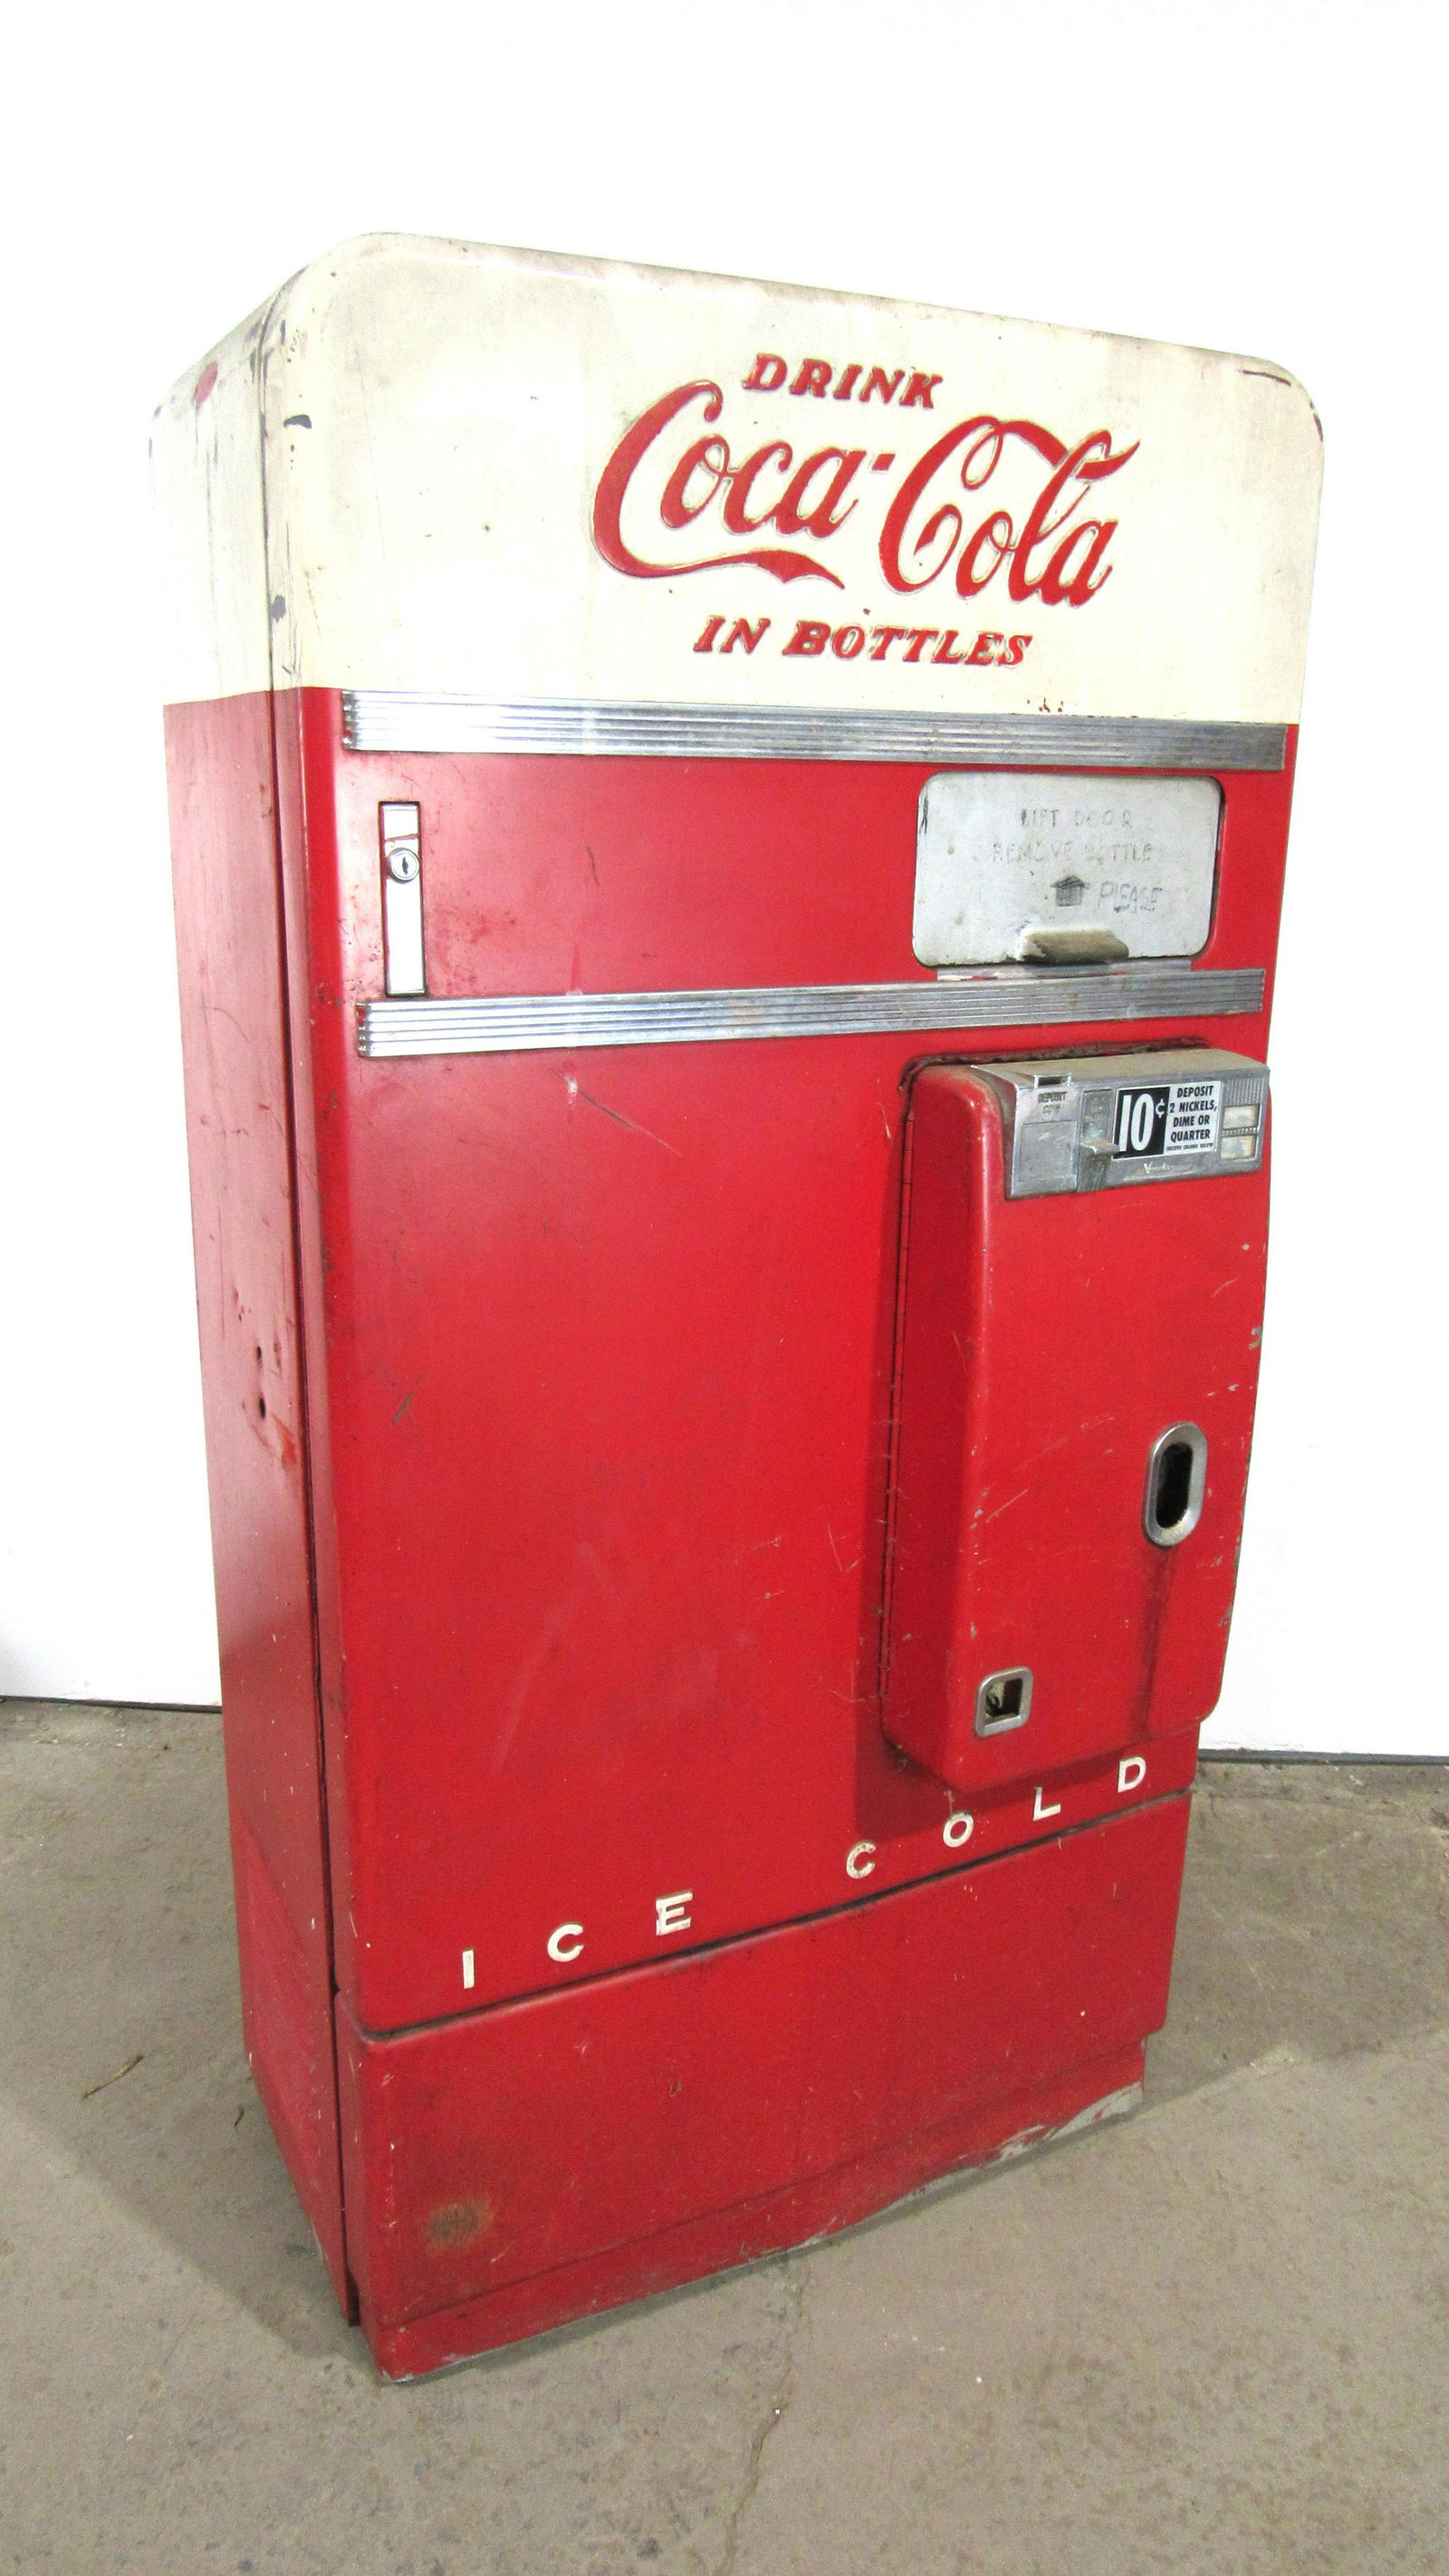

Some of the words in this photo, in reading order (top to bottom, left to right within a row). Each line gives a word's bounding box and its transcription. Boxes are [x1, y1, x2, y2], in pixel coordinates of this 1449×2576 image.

[743, 353, 943, 409] DRINK
[592, 379, 1141, 608] Coca-Cola
[693, 614, 771, 654] IN
[782, 620, 1032, 667] BOTTLES
[1074, 810, 1133, 828] DOOR
[1177, 1086, 1214, 1098] DEPOSIT
[1169, 1102, 1175, 1113] 2
[1179, 1100, 1217, 1112] NICKELS,
[1173, 1116, 1195, 1128] DIME
[1198, 1115, 1210, 1125] OR
[1171, 1129, 1210, 1142] QUARTER
[462, 1889, 694, 1989] ICE
[844, 1755, 1147, 1879] COLD
